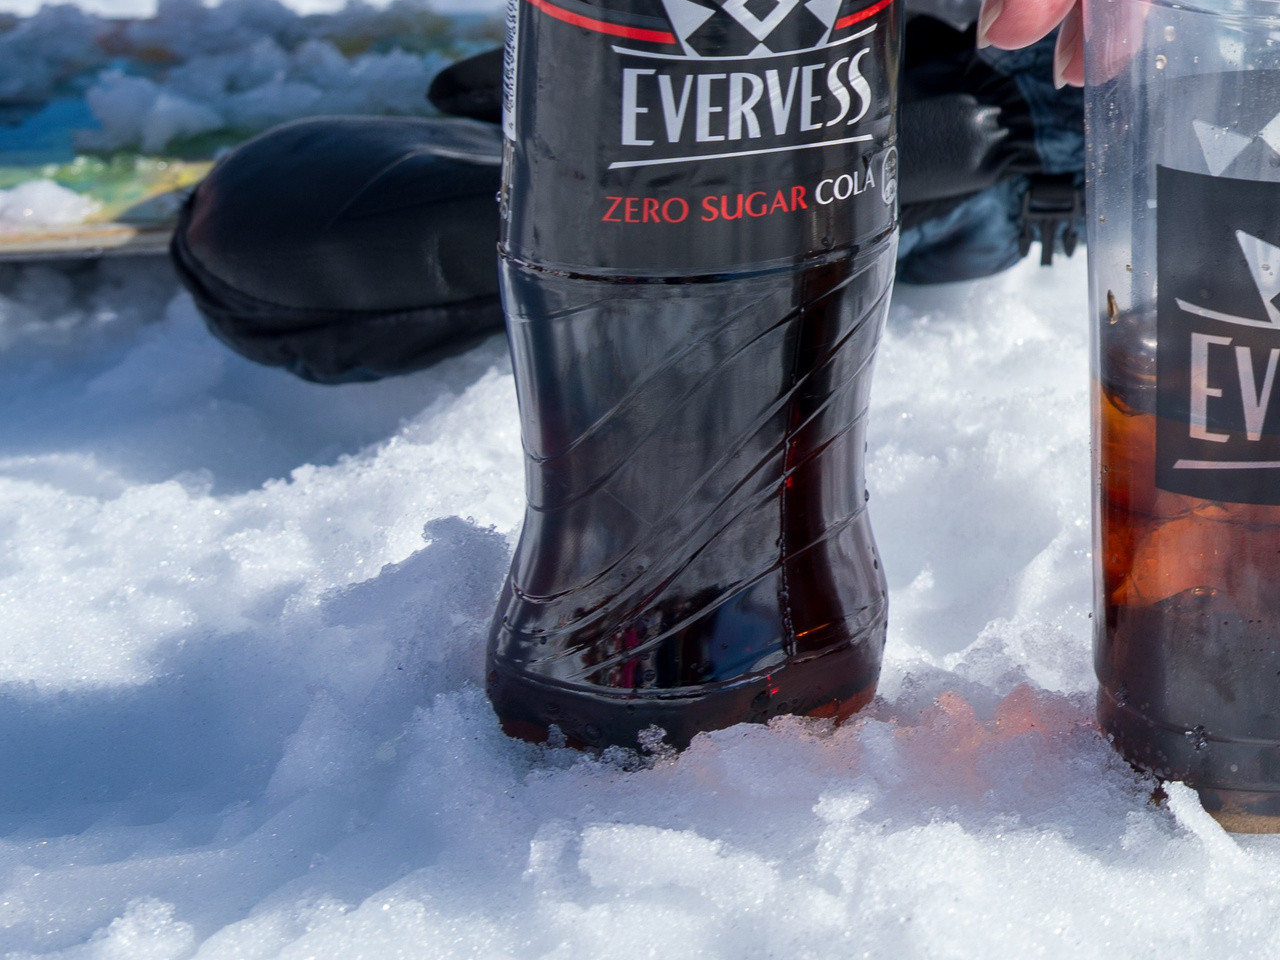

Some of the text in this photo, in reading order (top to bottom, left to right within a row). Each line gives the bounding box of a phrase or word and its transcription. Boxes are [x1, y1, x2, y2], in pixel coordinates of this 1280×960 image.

[622, 48, 872, 146] EVERVESS
[602, 196, 690, 224] ZERO
[701, 186, 808, 222] SUGAR
[815, 166, 876, 206] COLA
